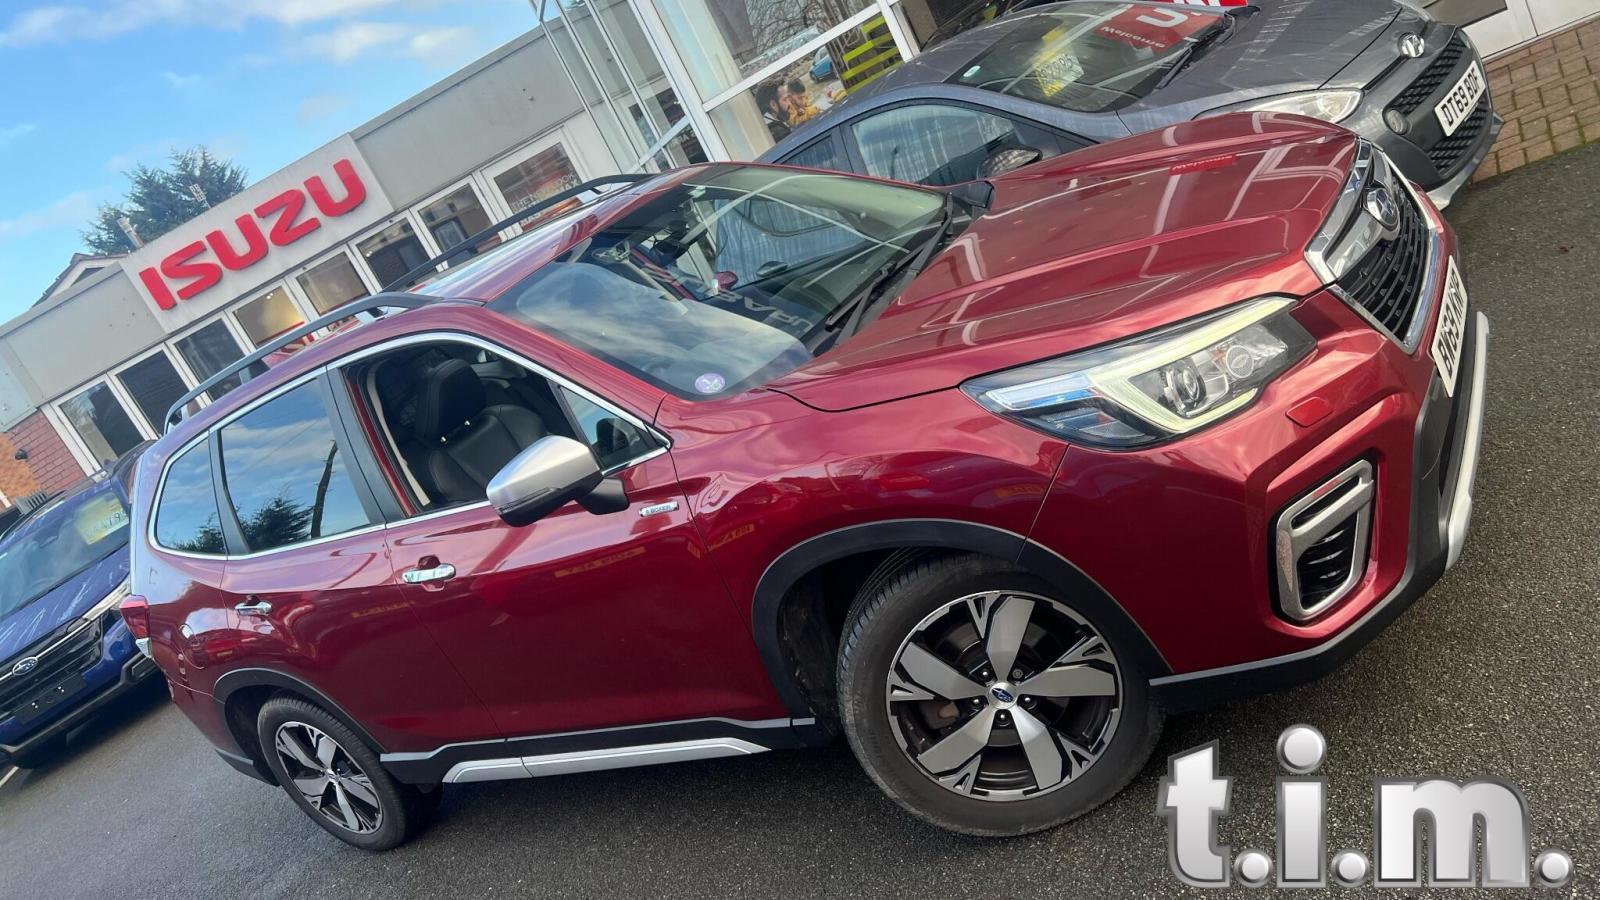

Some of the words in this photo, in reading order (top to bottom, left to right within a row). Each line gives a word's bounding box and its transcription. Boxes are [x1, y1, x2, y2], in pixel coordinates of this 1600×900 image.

[1441, 85, 1469, 127] DT69
[1464, 68, 1480, 100] BDF
[138, 159, 367, 311] ISUZU
